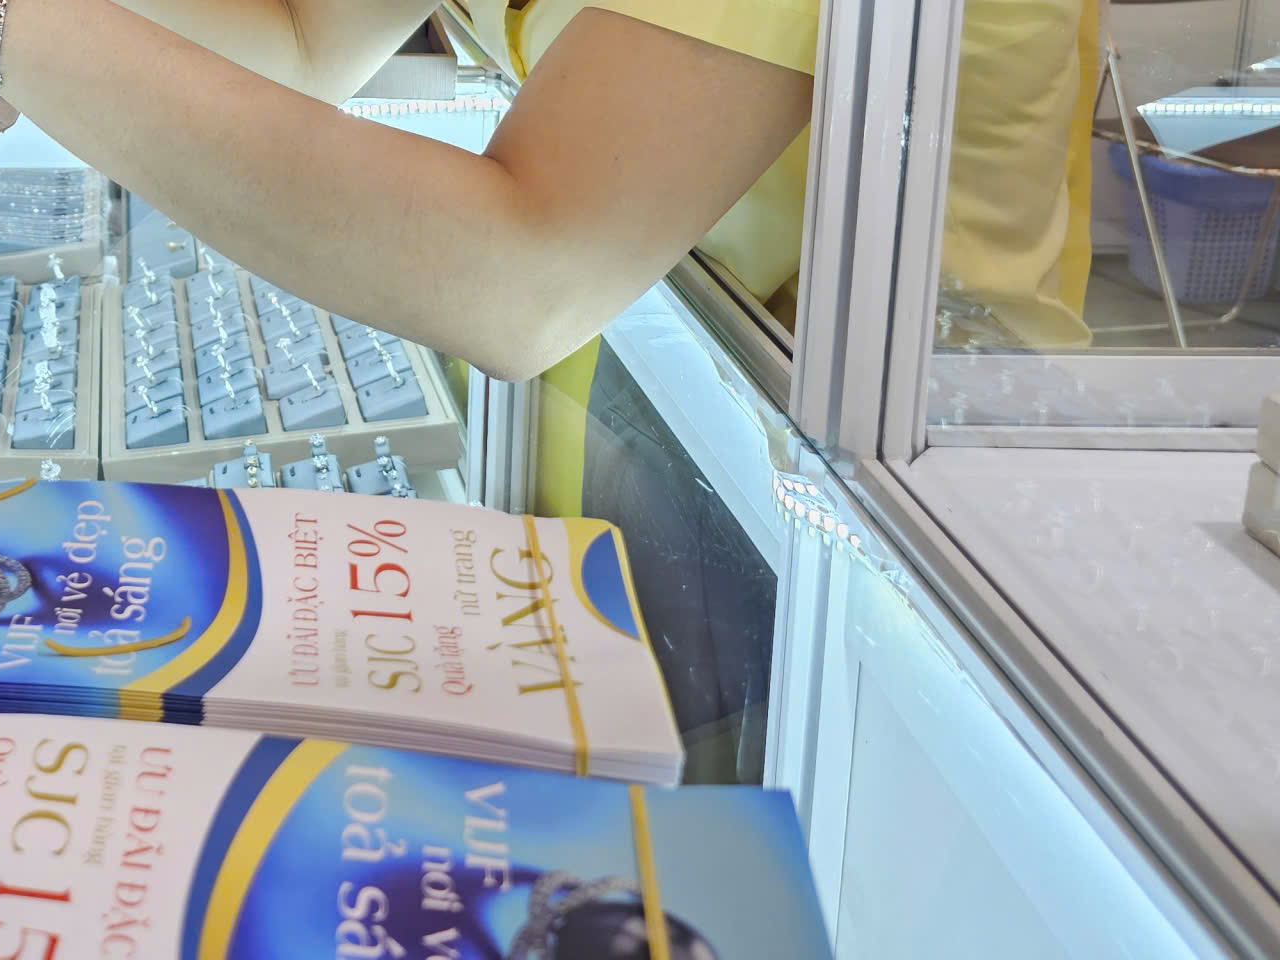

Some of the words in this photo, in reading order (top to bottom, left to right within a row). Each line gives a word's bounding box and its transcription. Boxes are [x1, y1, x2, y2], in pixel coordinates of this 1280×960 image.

[62, 500, 112, 564] đẹp
[287, 512, 324, 569] BIỆT
[449, 529, 477, 584] trang
[55, 572, 93, 601] vẻ
[101, 536, 168, 623] sáng
[287, 576, 324, 622] ĐẶC
[346, 519, 414, 623] 15%
[53, 606, 83, 636] nơi
[453, 590, 481, 616] nữ
[485, 545, 585, 696] VÀNG
[364, 633, 423, 695] SJC
[432, 625, 464, 657] tặng
[433, 662, 475, 696] Quà
[11, 737, 90, 857] SJC
[100, 769, 122, 810] gian
[135, 746, 173, 796] ƯU
[120, 805, 164, 871] ĐÃI
[340, 764, 408, 862] toả
[422, 844, 464, 912] nơi
[100, 880, 152, 958] ĐẶC
[335, 880, 408, 960] sá
